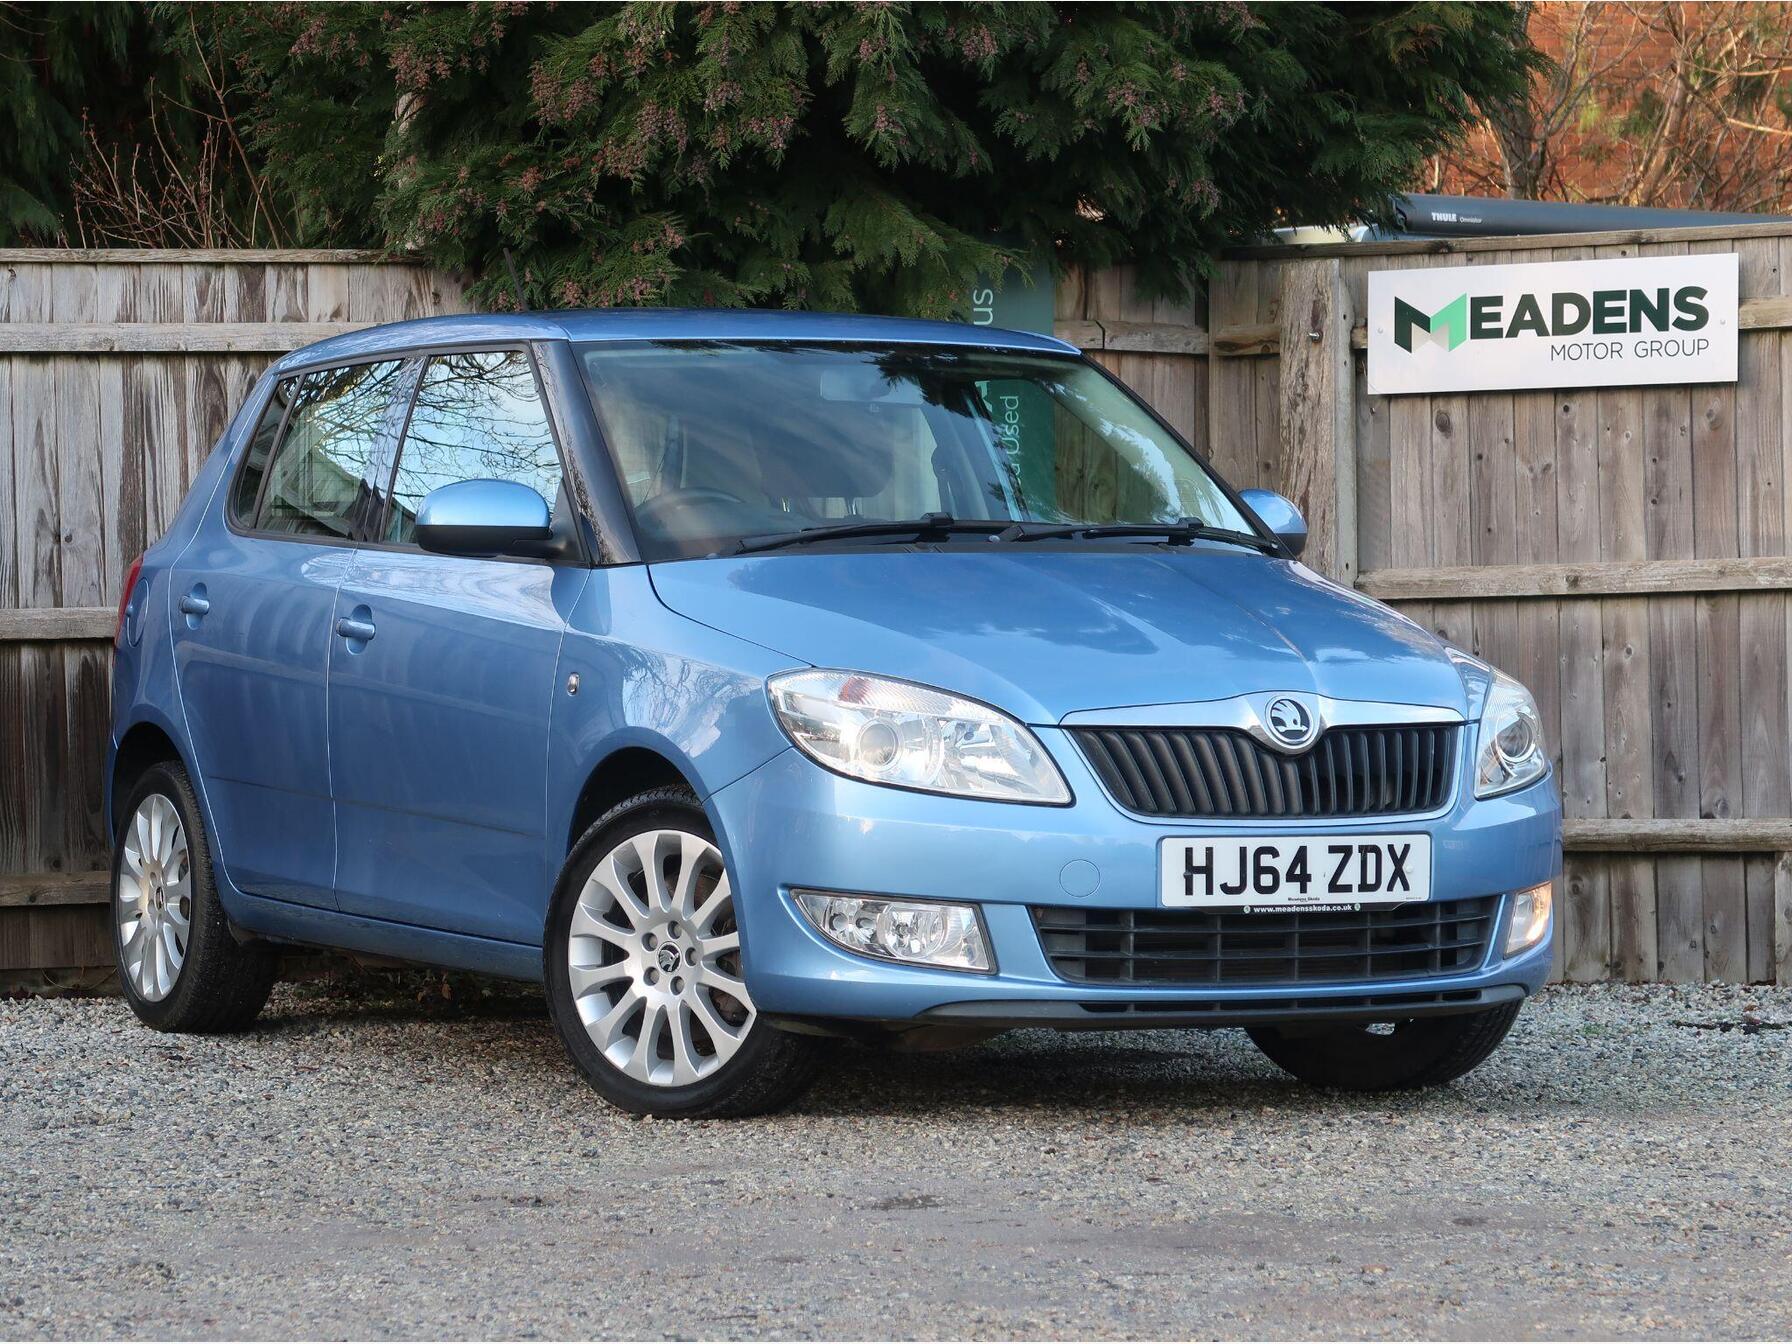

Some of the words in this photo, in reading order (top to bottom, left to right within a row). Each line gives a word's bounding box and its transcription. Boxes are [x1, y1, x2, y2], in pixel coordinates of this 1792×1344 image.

[1431, 211, 1458, 222] THULE
[1394, 286, 1710, 355] MEADENS
[1551, 342, 1623, 362] MOTOR
[1634, 338, 1710, 359] GROUP
[1000, 395, 1020, 455] Used
[1184, 845, 1312, 896] HJ64
[1328, 843, 1411, 894] ZDX
[1253, 903, 1353, 914] www.meadensskoda.co.uk
